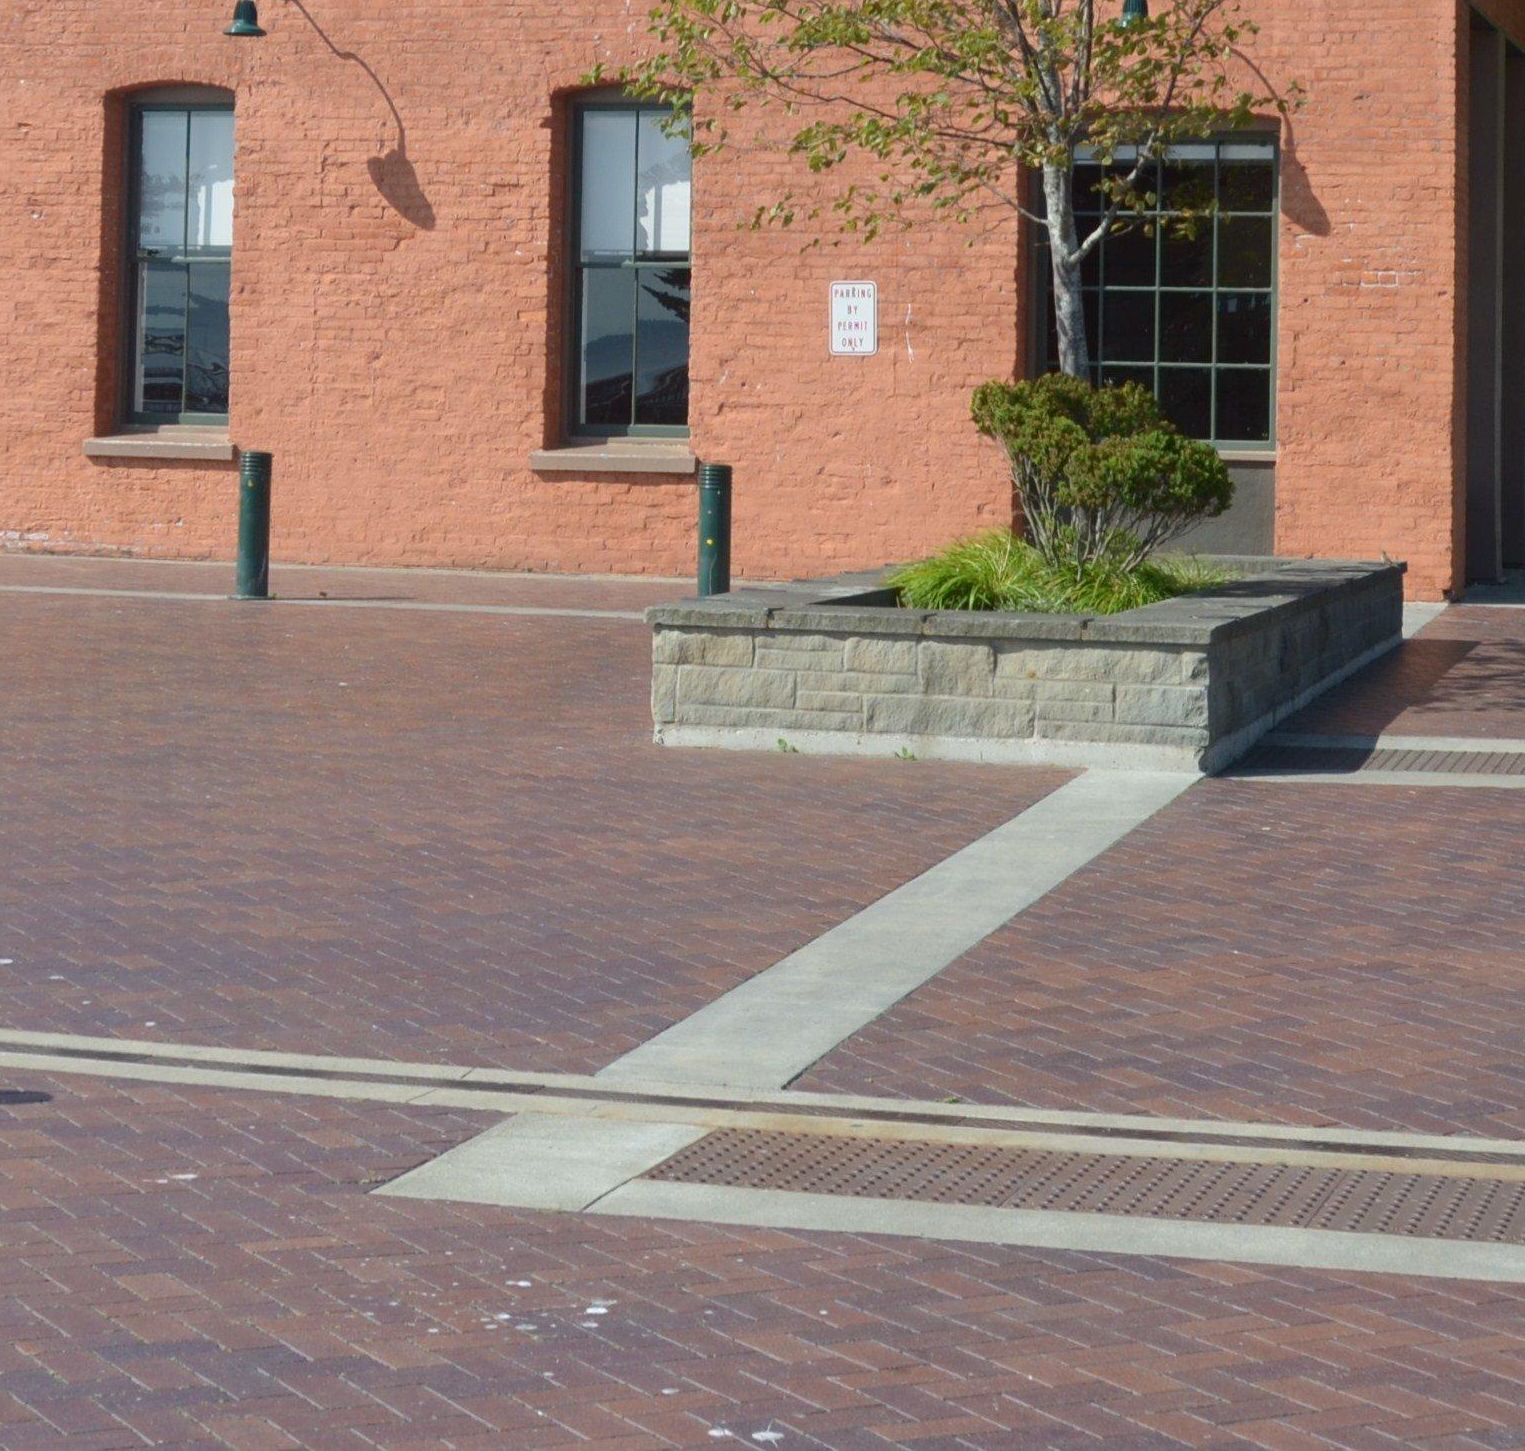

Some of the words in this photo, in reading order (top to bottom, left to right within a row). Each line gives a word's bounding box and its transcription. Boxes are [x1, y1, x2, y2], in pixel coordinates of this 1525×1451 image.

[834, 287, 872, 298] PARKING
[847, 305, 858, 314] BY
[837, 321, 867, 330] PERMIT
[842, 338, 863, 347] ONLY
